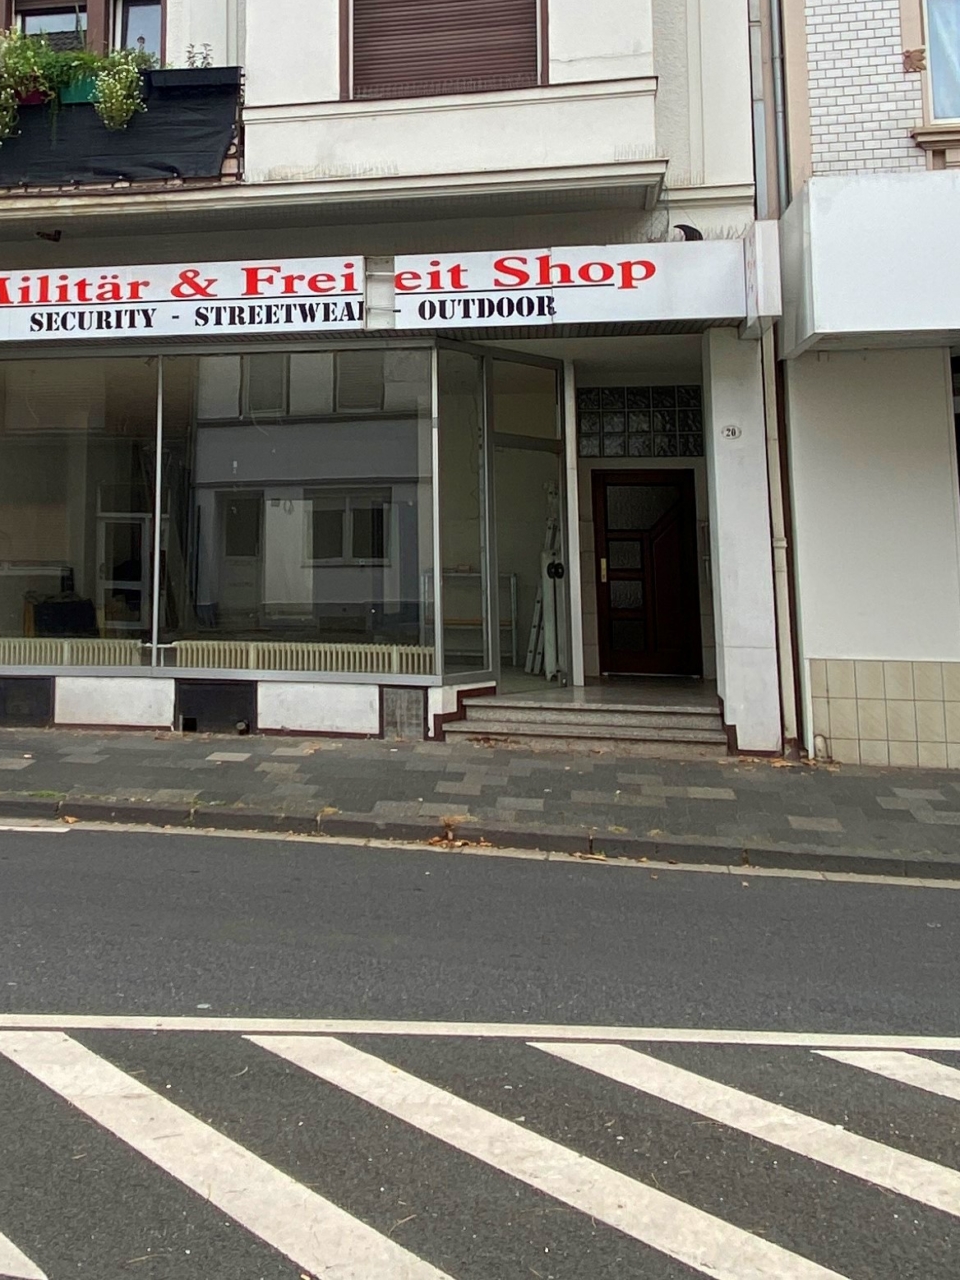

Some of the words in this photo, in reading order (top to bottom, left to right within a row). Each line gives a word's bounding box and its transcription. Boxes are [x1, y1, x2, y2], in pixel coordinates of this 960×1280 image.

[170, 269, 218, 298] &
[241, 260, 469, 297] Freieit
[493, 254, 657, 290] Shop
[29, 308, 157, 333] SECURITY
[418, 295, 557, 320] OUTDOOR
[725, 427, 737, 437] 20
